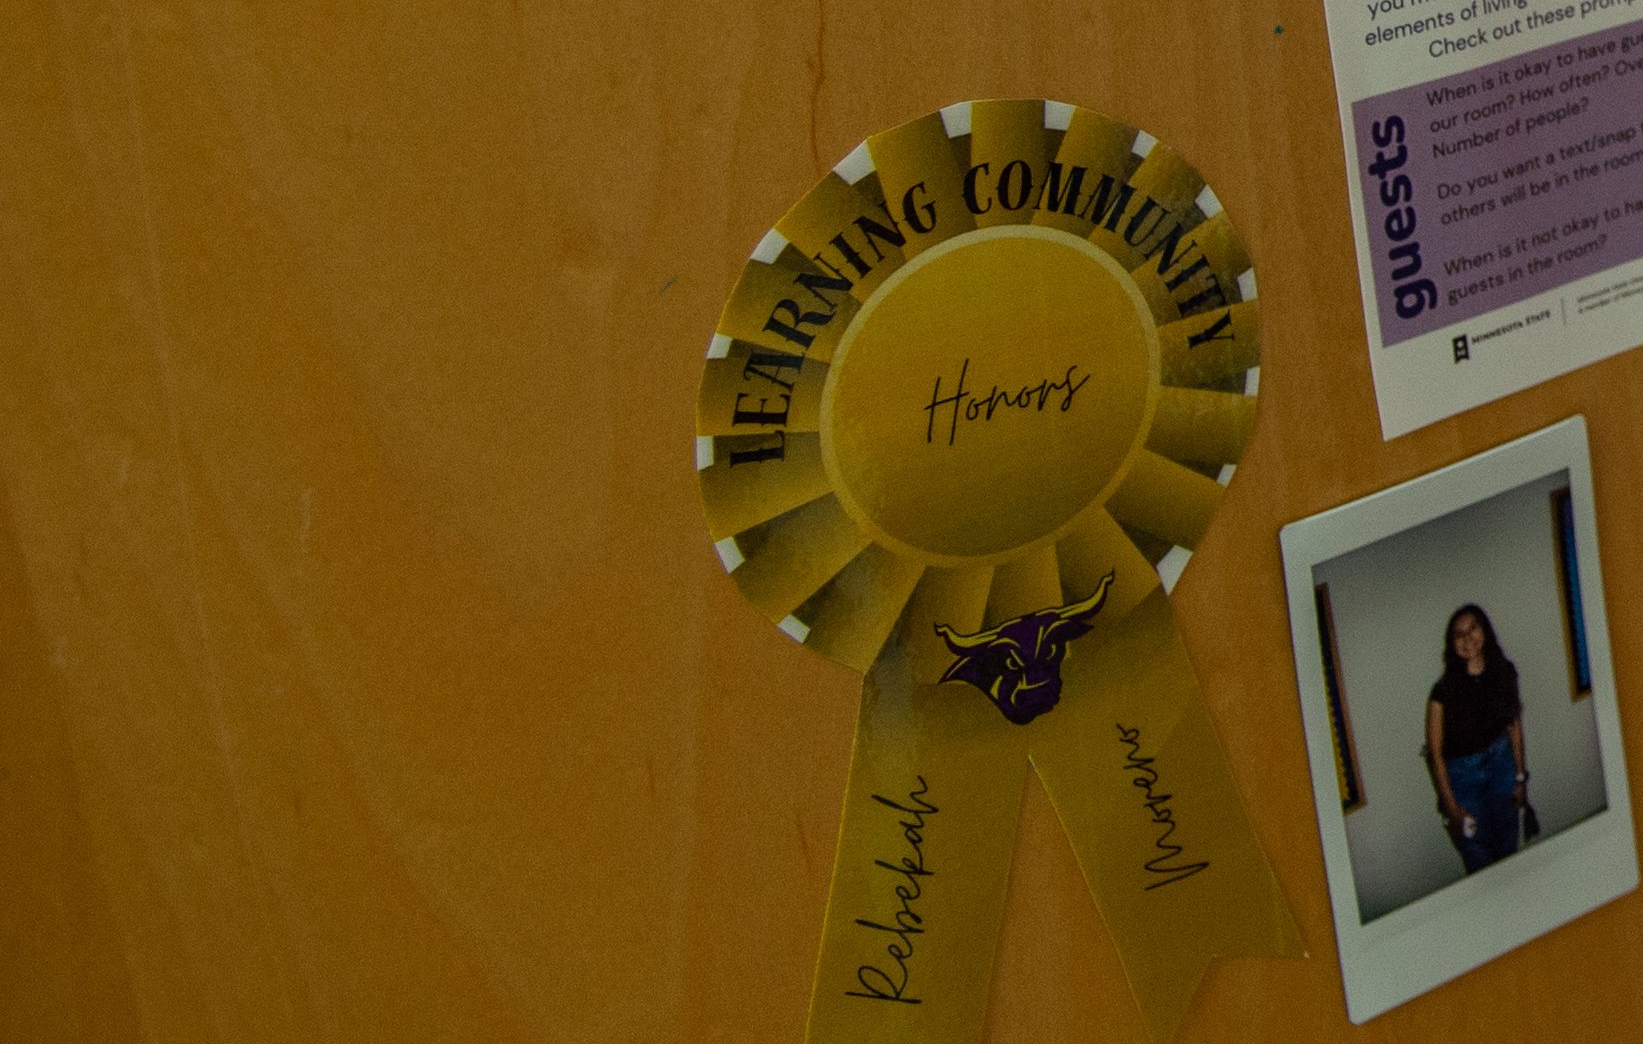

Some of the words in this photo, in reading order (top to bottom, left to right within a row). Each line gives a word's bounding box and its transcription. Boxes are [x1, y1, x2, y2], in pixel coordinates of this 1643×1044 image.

[1363, 10, 1456, 47] elements
[1458, 0, 1478, 22] of
[1427, 27, 1489, 59] Check
[1490, 17, 1522, 41] out
[1524, 4, 1576, 30] these
[1425, 82, 1479, 107] When
[1480, 76, 1496, 91] is
[1497, 70, 1511, 86] it
[1513, 59, 1551, 82] okay
[1554, 51, 1575, 68] to
[1576, 39, 1617, 61] have
[1428, 113, 1459, 133] our
[1462, 92, 1516, 123] room?
[1518, 85, 1555, 105] How
[1557, 63, 1611, 94] often?
[1431, 127, 1501, 158] Number
[1503, 116, 1521, 137] of
[1523, 95, 1589, 135] people?
[1435, 181, 1463, 201] Do
[1465, 171, 1499, 195] you
[1501, 155, 1541, 180] want
[1544, 151, 1556, 166] a
[1557, 126, 1637, 161] text/snap
[1439, 197, 1497, 226] others
[1499, 183, 1527, 207] will
[1528, 179, 1551, 197] be
[1553, 172, 1570, 188] in
[1571, 163, 1600, 182] the
[1366, 114, 1438, 320] guests
[1442, 250, 1495, 276] When
[1497, 244, 1513, 259] is
[1514, 237, 1528, 253] it
[1529, 226, 1558, 247] not
[1560, 214, 1599, 237] okay
[1601, 206, 1622, 223] to
[1446, 273, 1505, 307] guests
[1507, 265, 1524, 283] in
[1525, 255, 1554, 275] the
[1555, 232, 1608, 264] room?
[728, 181, 938, 468] LEARNING
[962, 159, 1235, 350] COMMUNITY
[923, 358, 1091, 446] Honors
[845, 775, 939, 1004] Rebekah
